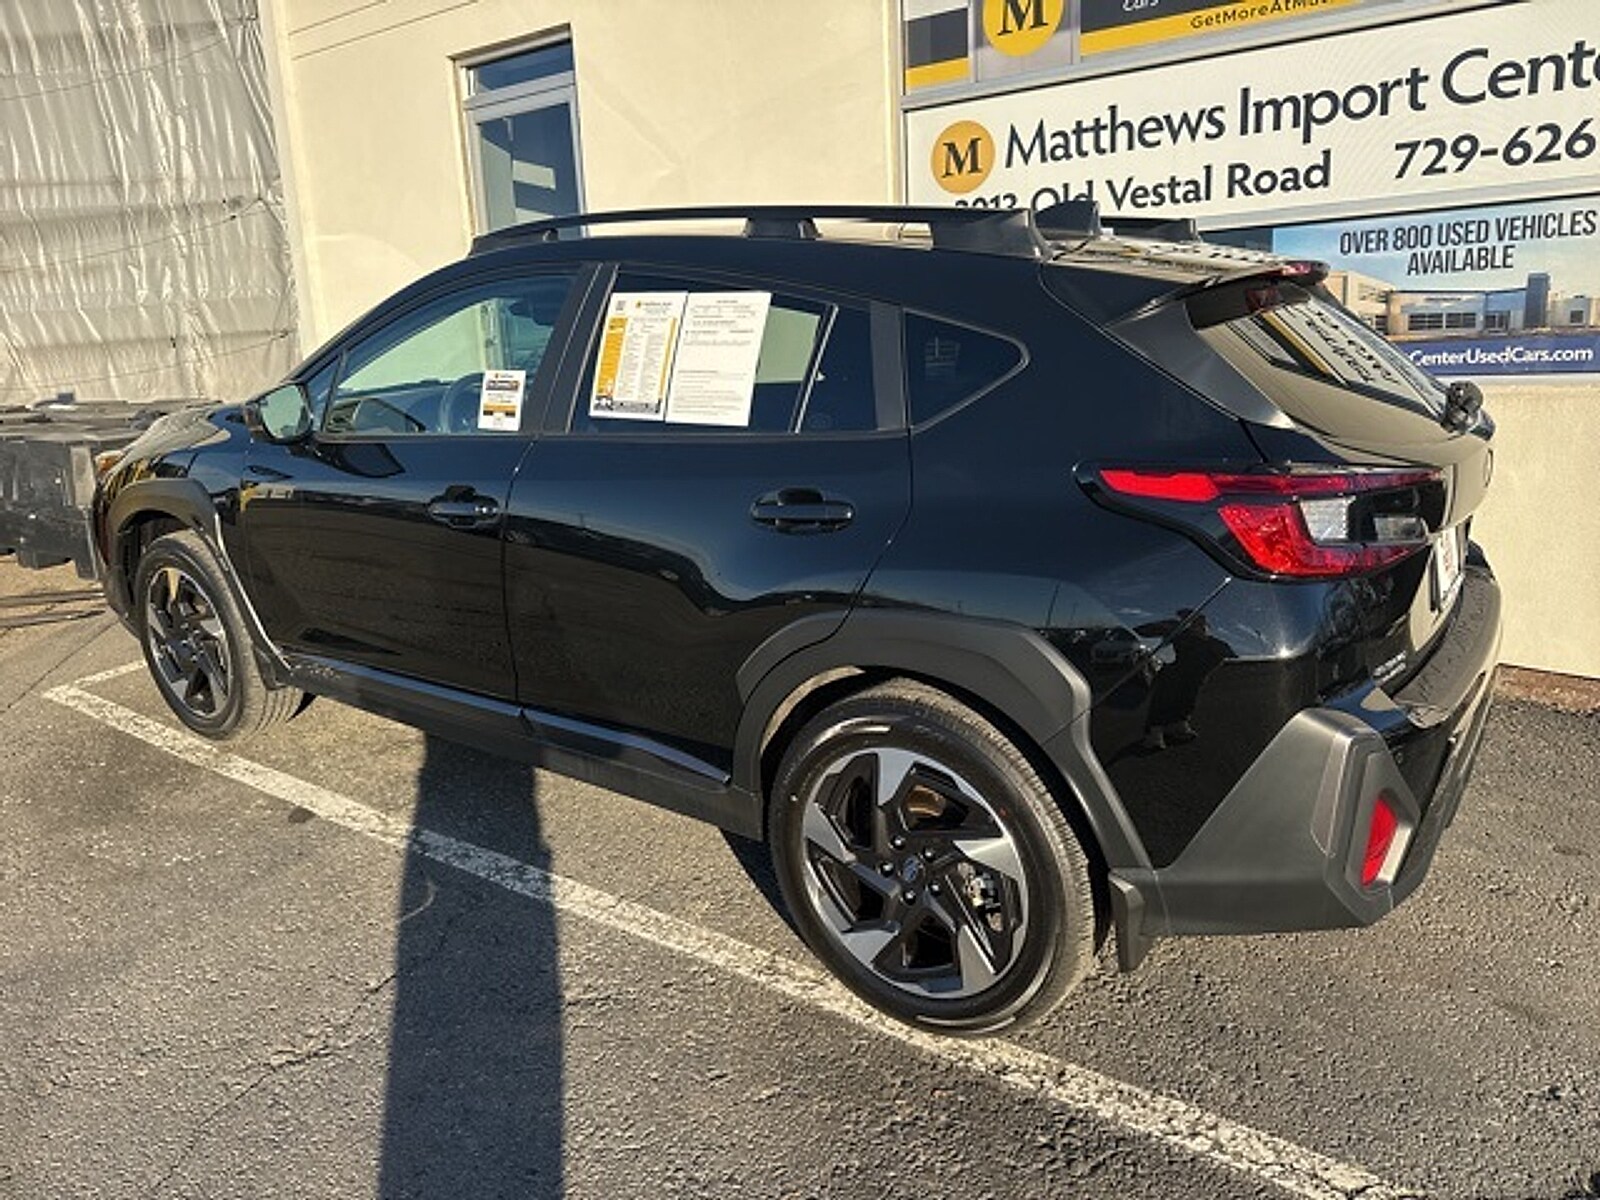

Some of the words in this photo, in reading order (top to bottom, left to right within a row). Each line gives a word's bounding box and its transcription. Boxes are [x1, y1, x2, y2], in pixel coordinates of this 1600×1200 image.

[997, 0, 1048, 36] M
[1004, 105, 1226, 169] Matthews
[1238, 67, 1429, 144] Import
[1442, 40, 1600, 104] Cent
[941, 137, 983, 178] M
[1394, 118, 1596, 179] 729-626
[1106, 164, 1213, 211] Vestal
[1226, 149, 1332, 198] Road
[1339, 227, 1389, 256] OVER
[1392, 225, 1432, 251] 800
[1437, 219, 1490, 246] USED
[1494, 209, 1598, 241] VEHICLES
[1406, 245, 1516, 276] AVAILABLE
[1404, 346, 1593, 367] CenterUsedCars.com
